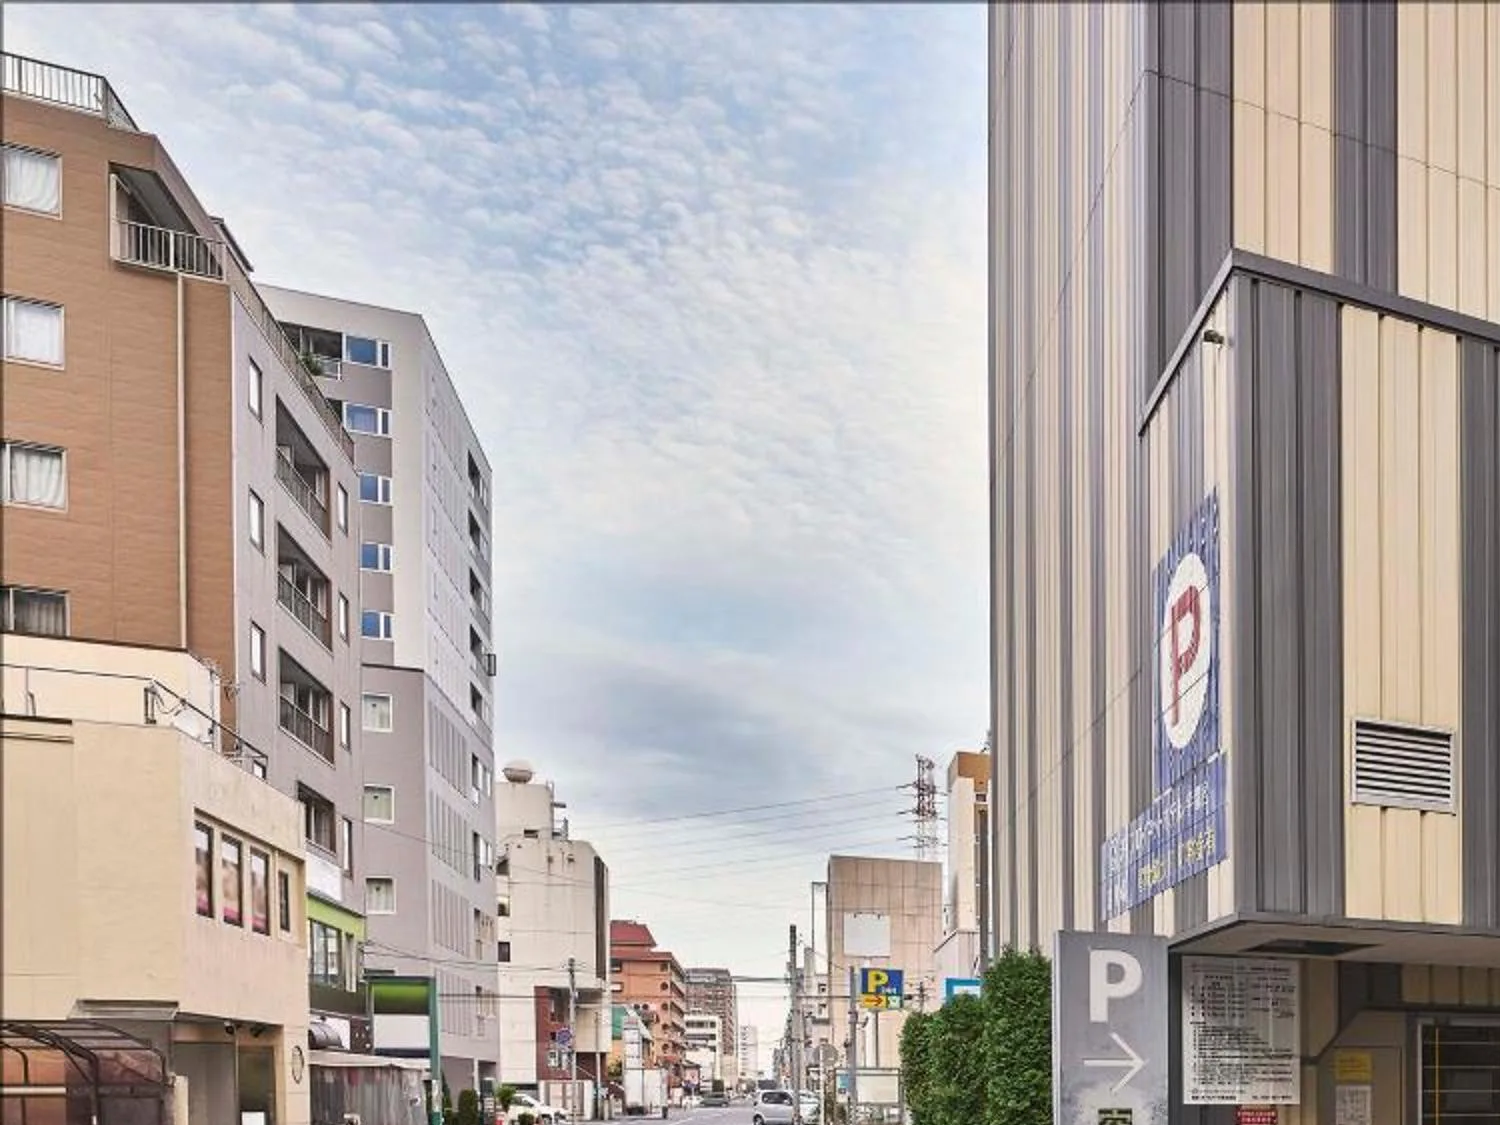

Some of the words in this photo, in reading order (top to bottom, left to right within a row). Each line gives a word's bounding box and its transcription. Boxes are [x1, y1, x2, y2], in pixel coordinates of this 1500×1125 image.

[1171, 585, 1201, 727] P
[868, 971, 889, 993] P
[1089, 949, 1143, 1023] P
